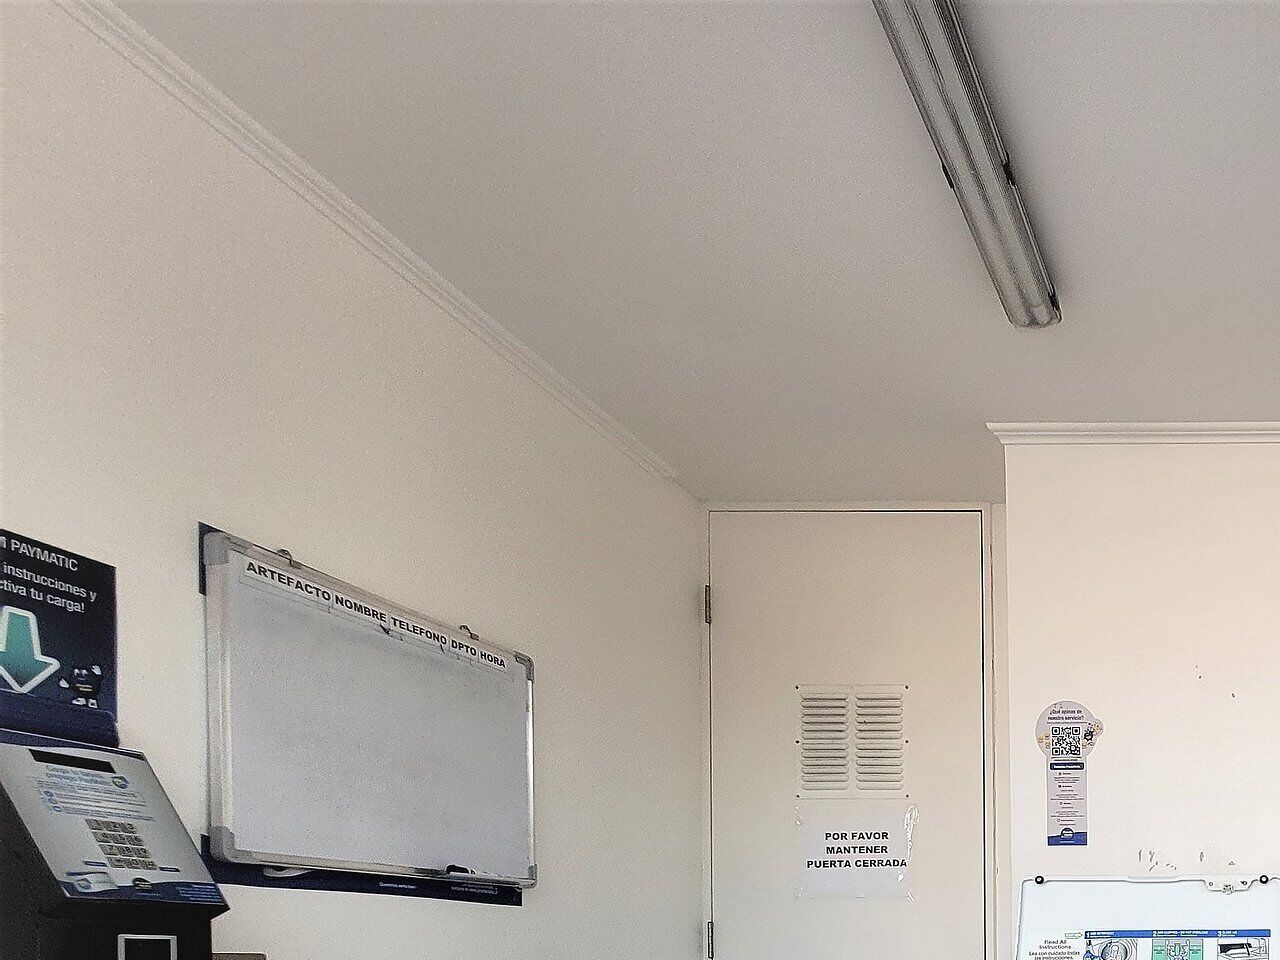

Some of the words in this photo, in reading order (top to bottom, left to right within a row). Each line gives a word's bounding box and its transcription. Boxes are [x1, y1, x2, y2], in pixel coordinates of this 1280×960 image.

[10, 539, 79, 571] PAYMATIC
[3, 561, 87, 598] instrucciones
[89, 590, 97, 602] y
[30, 586, 43, 601] tu
[46, 594, 85, 613] carga!
[246, 561, 332, 602] ARTEFACTO
[334, 594, 388, 624] NOMBRE
[390, 616, 448, 646] TELEFONO
[450, 639, 477, 657] DPTO
[480, 651, 506, 669] HORA
[825, 832, 848, 840] POR
[851, 832, 889, 840] FAVOR
[826, 845, 888, 854] MANTENER
[806, 860, 851, 868] PUERTA
[854, 859, 908, 868] CERRADA
